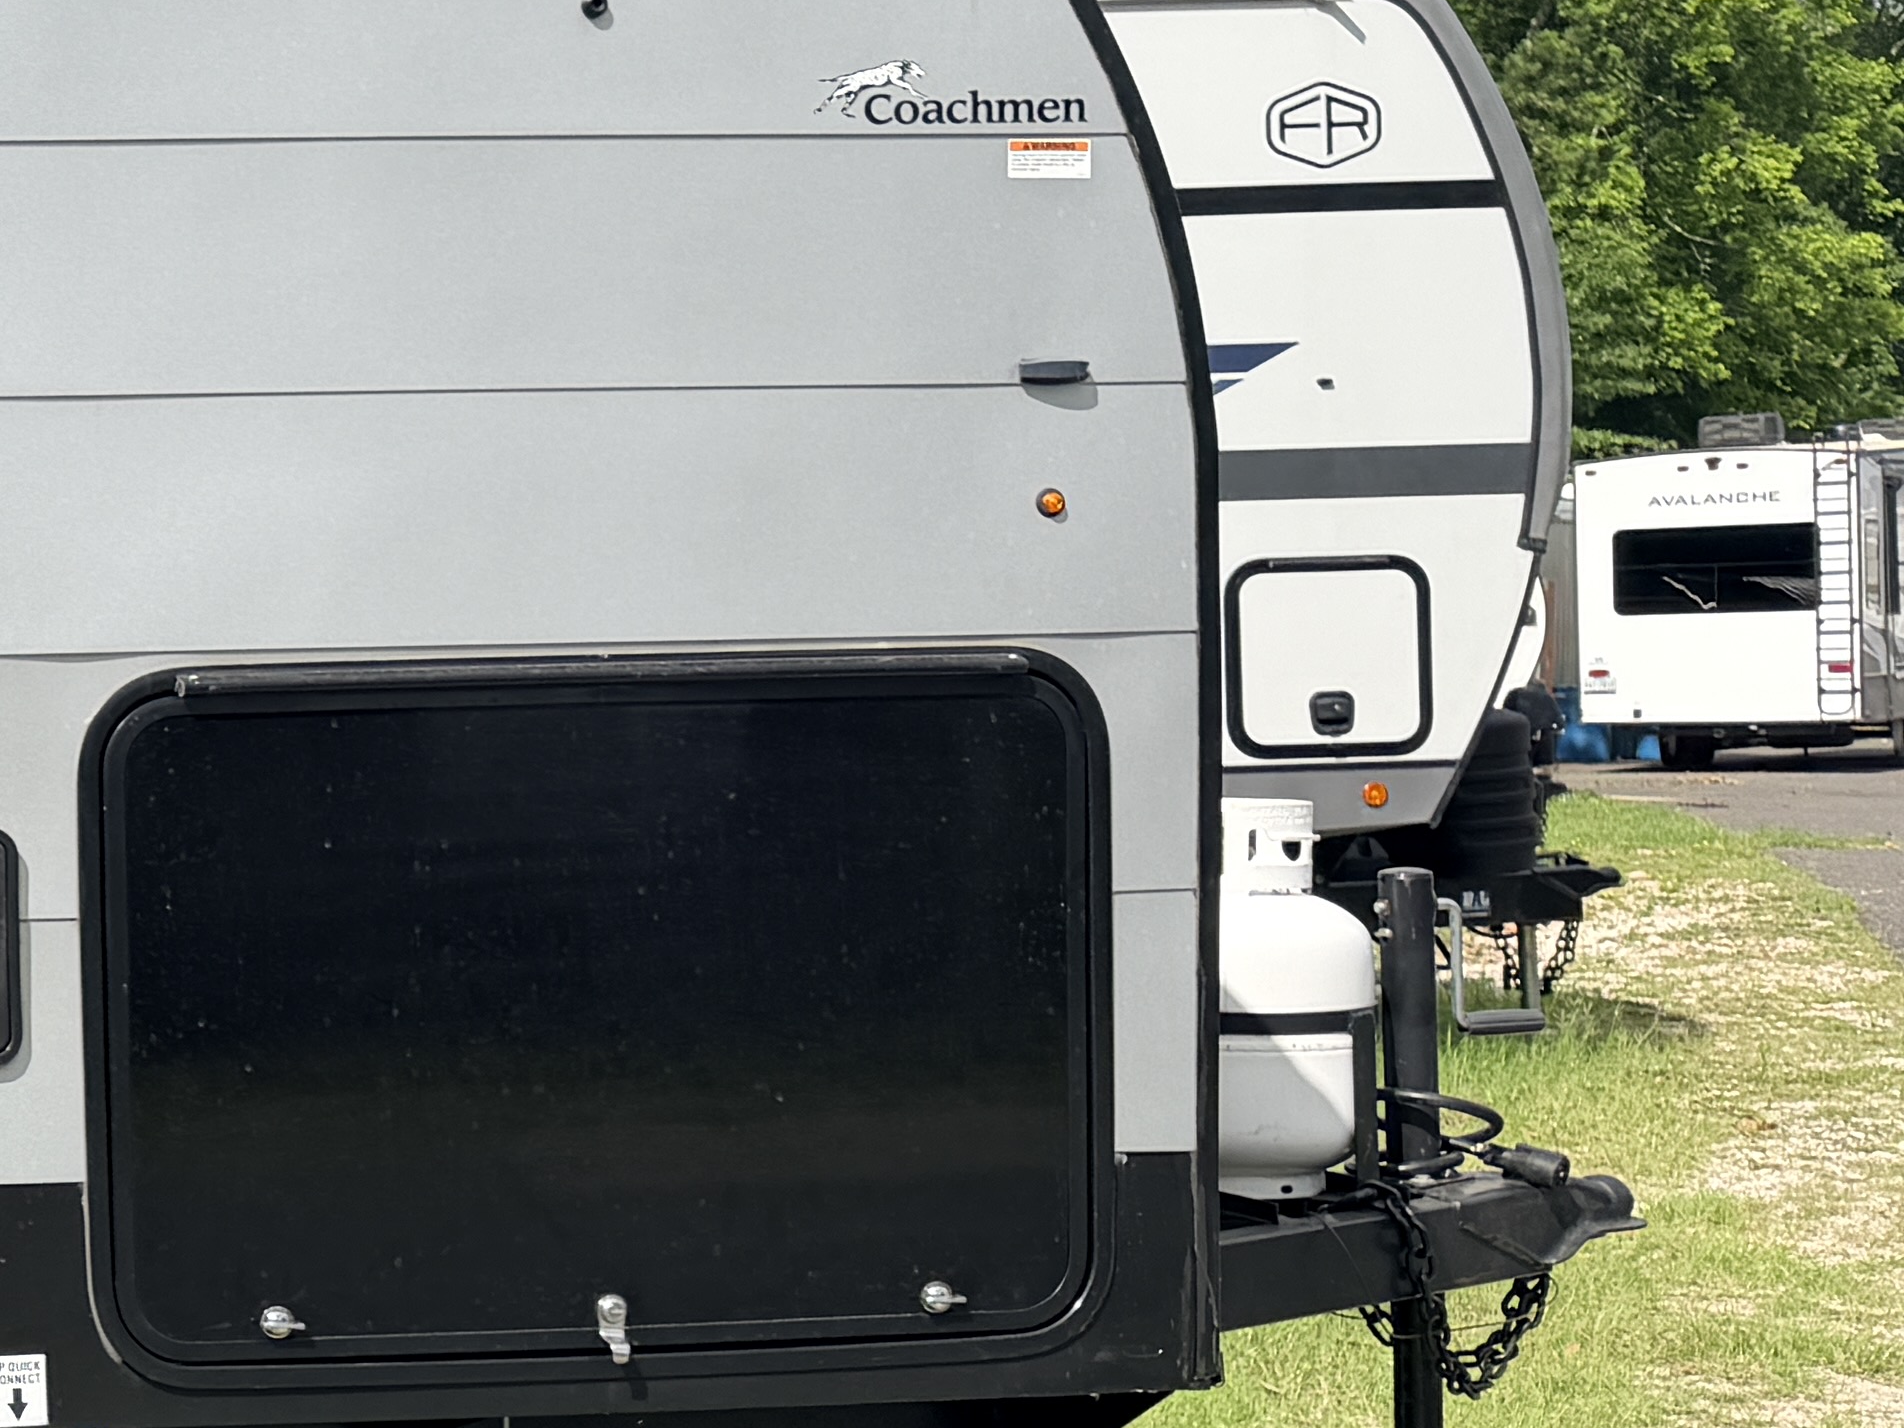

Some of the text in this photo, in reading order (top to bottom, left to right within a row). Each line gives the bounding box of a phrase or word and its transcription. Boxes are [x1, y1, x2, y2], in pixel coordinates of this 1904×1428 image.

[864, 90, 1088, 125] Coachmen
[1647, 490, 1781, 508] AVALANCHE
[8, 1360, 41, 1372] QUICK
